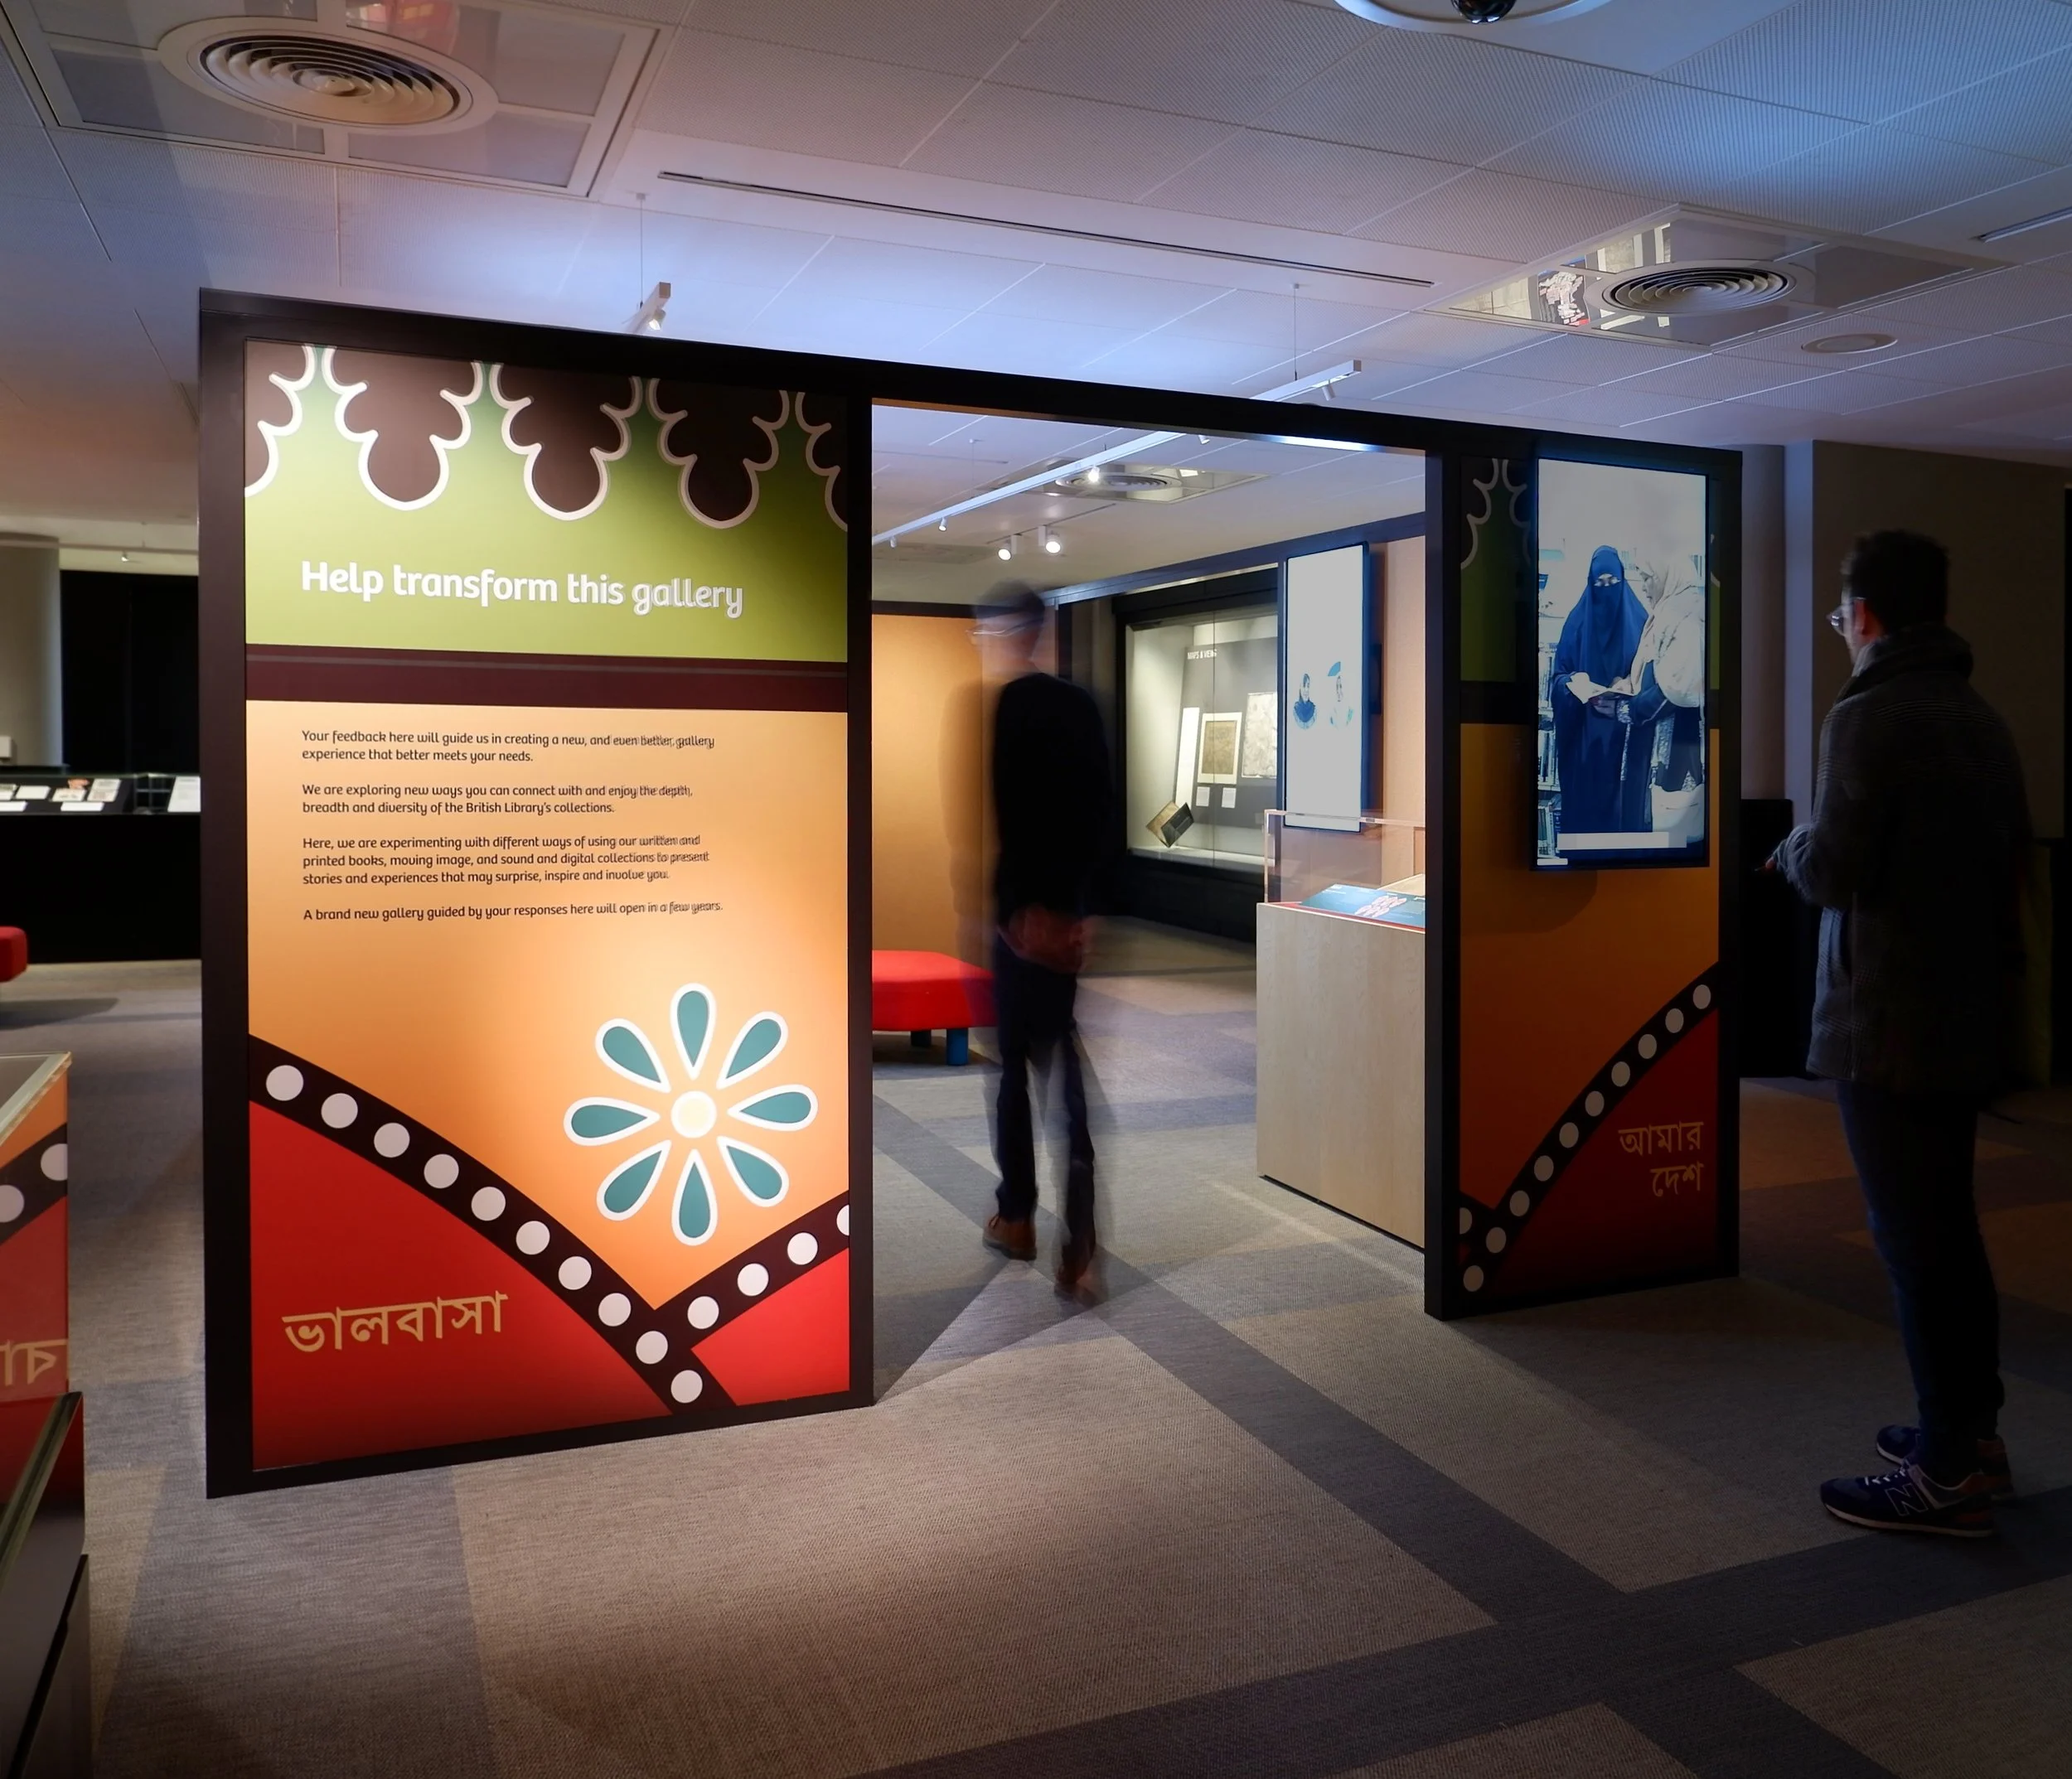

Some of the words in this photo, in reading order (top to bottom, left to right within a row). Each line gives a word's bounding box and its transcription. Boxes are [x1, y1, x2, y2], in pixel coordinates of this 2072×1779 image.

[303, 562, 383, 602] Help
[394, 565, 557, 607] transform
[568, 573, 623, 604] this
[632, 578, 743, 618] gallery
[302, 730, 330, 741] Your
[332, 730, 386, 744] feedback
[389, 732, 414, 742] here
[417, 732, 440, 743] will
[442, 732, 473, 747] guide
[477, 736, 489, 744] us
[491, 732, 501, 744] in
[504, 733, 549, 747] creating
[552, 737, 559, 745] a
[562, 737, 587, 747] new,
[590, 735, 612, 745] and
[613, 737, 640, 746] even
[675, 735, 714, 750] gallery
[302, 748, 366, 761] experience
[369, 749, 393, 760] that
[396, 749, 431, 761] better
[433, 750, 467, 761] meets
[470, 752, 496, 764] your
[499, 751, 533, 761] needs.
[302, 784, 321, 795] We
[324, 786, 343, 795] are
[346, 784, 401, 799] exploring
[404, 786, 428, 795] new
[432, 787, 463, 799] ways
[466, 787, 487, 799] you
[490, 787, 510, 795] can
[512, 785, 556, 795] connect
[558, 785, 583, 795] with
[585, 786, 607, 795] and
[608, 785, 638, 799] enjoy
[640, 785, 658, 795] the
[303, 802, 349, 813] breadth
[352, 802, 375, 813] and
[378, 802, 428, 816] diversity
[430, 802, 443, 815] of
[445, 802, 463, 813] the
[466, 802, 501, 813] British
[505, 802, 551, 816] Library's
[554, 802, 616, 813] collections.
[303, 838, 334, 850] Here,
[337, 839, 356, 848] we
[358, 839, 377, 848] are
[380, 837, 462, 851] experimenting
[465, 836, 490, 848] with
[492, 836, 540, 850] different
[542, 839, 572, 850] ways
[574, 835, 586, 849] of
[588, 836, 617, 849] using
[619, 838, 637, 846] our
[639, 835, 678, 846] written
[679, 835, 700, 845] and
[303, 855, 346, 869] printed
[349, 855, 387, 868] books,
[390, 854, 433, 868] moving
[436, 854, 473, 868] image,
[477, 853, 498, 864] and
[501, 853, 534, 864] sound
[537, 853, 557, 863] and
[560, 853, 595, 867] digital
[598, 852, 656, 863] collections
[657, 852, 669, 863] to
[670, 851, 709, 865] present
[303, 873, 342, 884] stories
[346, 873, 368, 883] and
[371, 872, 438, 886] experiences
[441, 872, 465, 882] that
[467, 873, 492, 885] may
[496, 870, 542, 884] surprise,
[545, 870, 580, 883] inspire
[583, 869, 603, 880] and
[606, 869, 646, 880] involve
[303, 910, 312, 920] A
[316, 908, 351, 920] brand
[354, 911, 379, 919] new
[382, 907, 424, 922] gallery
[427, 906, 465, 921] guided
[468, 906, 482, 920] by
[486, 907, 511, 920] your
[514, 906, 568, 918] responses
[570, 904, 593, 914] here
[597, 903, 617, 913] will
[619, 905, 646, 916] open
[648, 902, 658, 912] in
[660, 904, 668, 912] a
[669, 902, 690, 915] few
[691, 902, 723, 915] years.
[1618, 1120, 1704, 1157] আমার
[1650, 1160, 1705, 1197] দেশ
[282, 1290, 509, 1352] ভালবাসা
[1885, 1482, 1929, 1516] N
